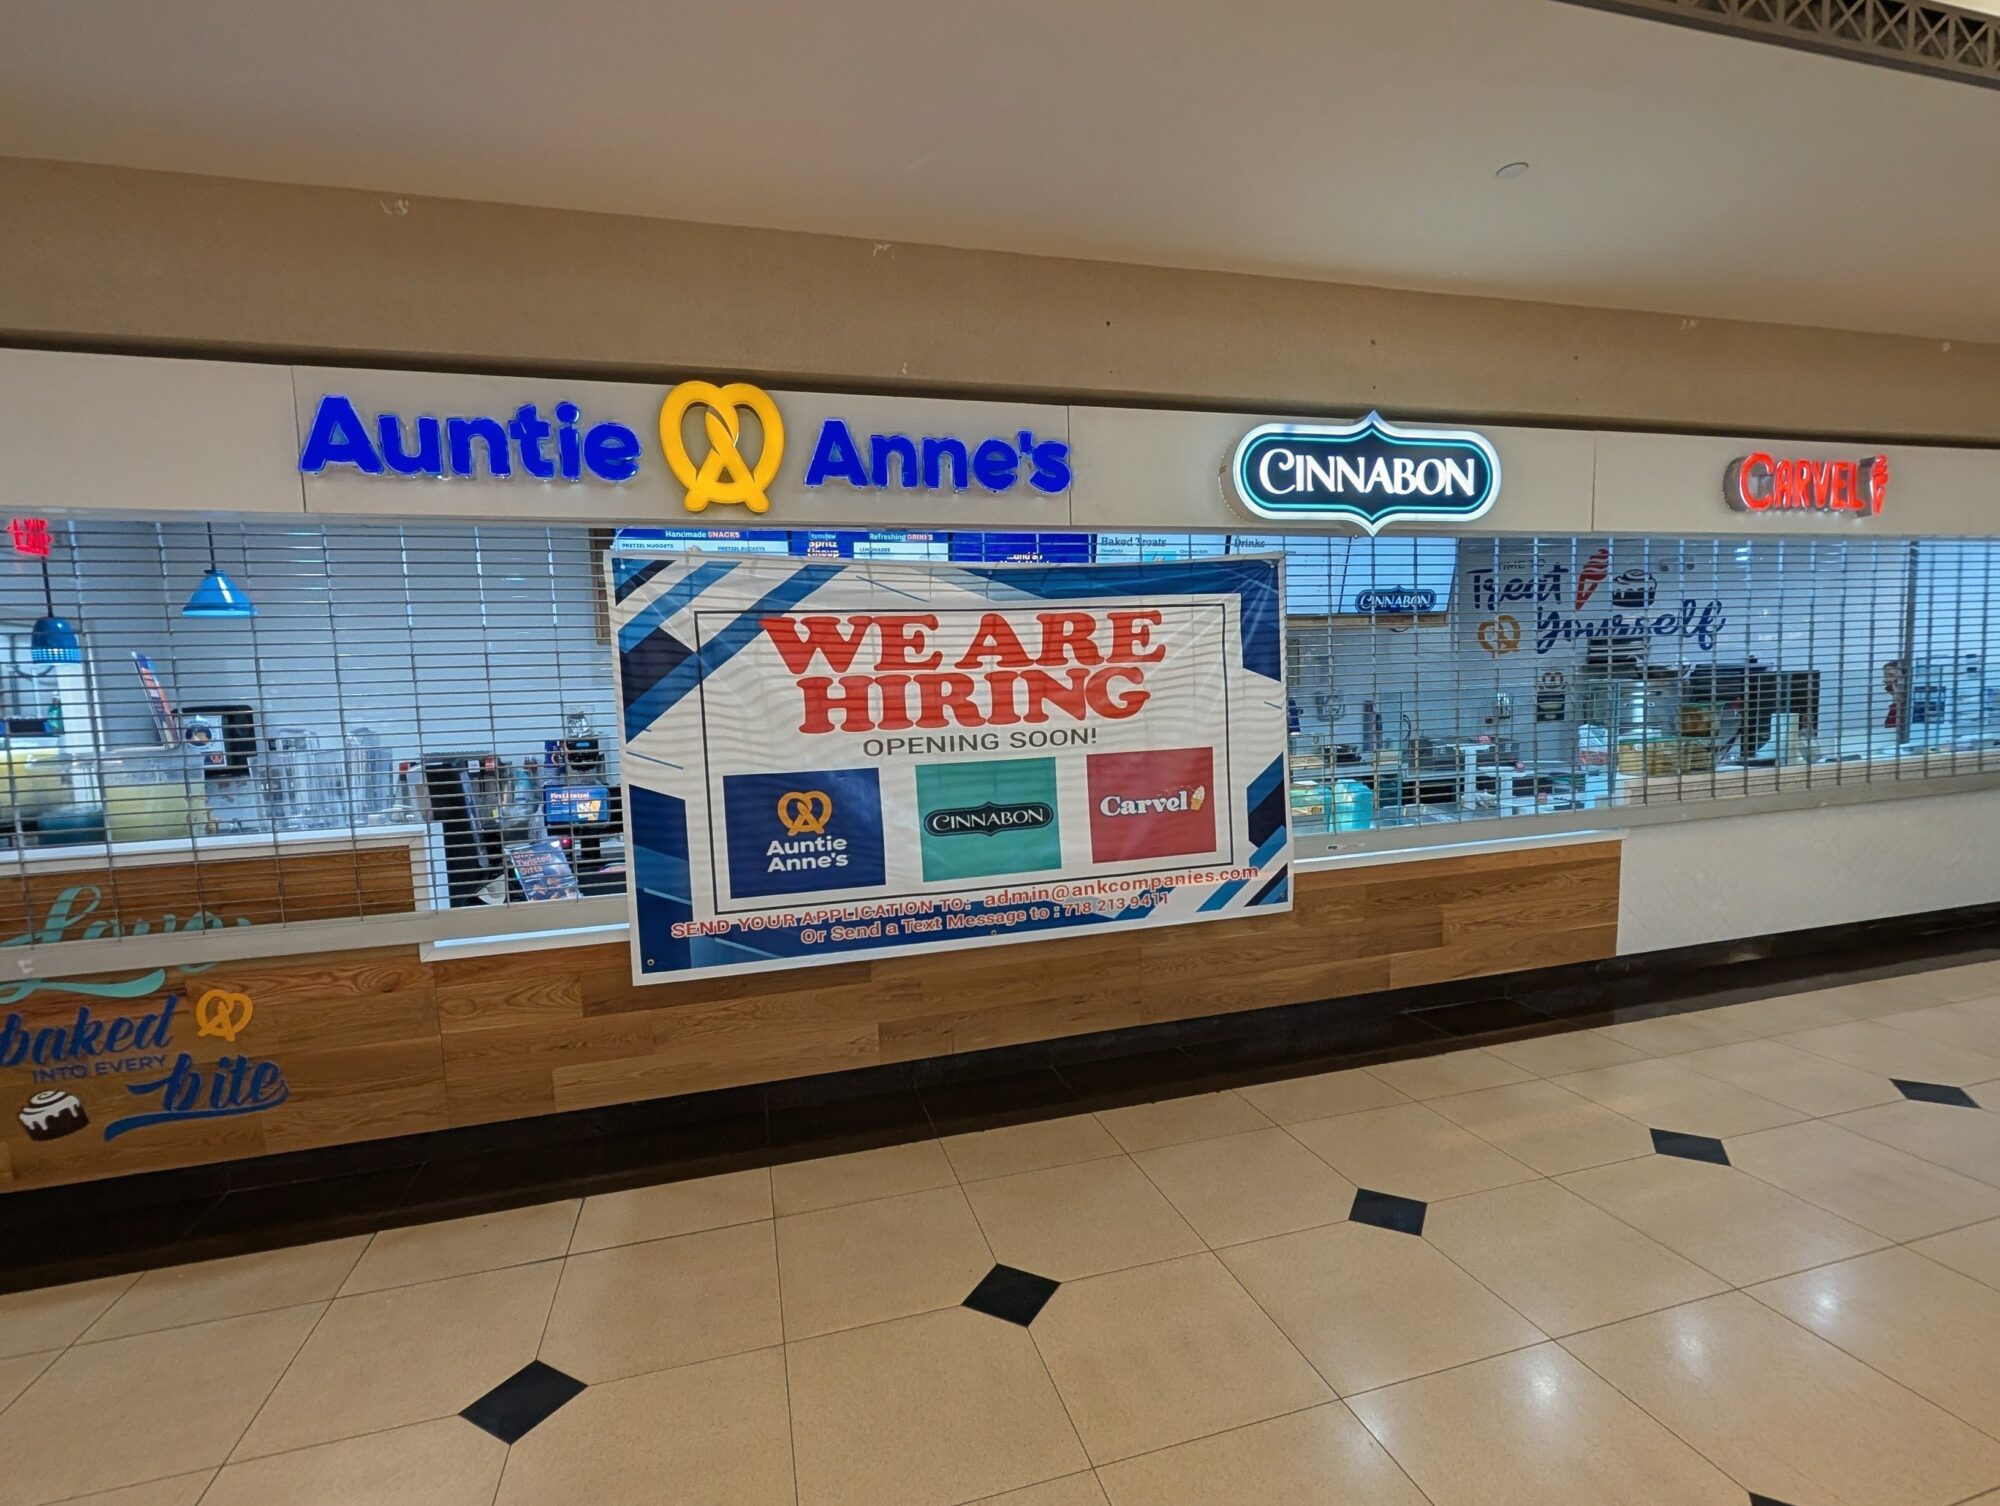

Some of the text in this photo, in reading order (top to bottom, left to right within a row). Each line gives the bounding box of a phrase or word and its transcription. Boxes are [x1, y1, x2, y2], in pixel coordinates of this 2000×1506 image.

[300, 394, 1071, 493] Auntie Anne's
[1259, 448, 1475, 496] CINNABON
[1740, 453, 1865, 511] CARVEL
[665, 530, 706, 538] Handmade
[869, 533, 906, 542] Refreshing
[1101, 536, 1166, 547] Baked Treats
[1234, 538, 1265, 549] Drinks
[758, 610, 1167, 674] WE ARE
[796, 666, 1151, 734] HIRING
[863, 727, 1098, 757] OPENING SOON!
[1099, 790, 1188, 817] Carvel
[932, 808, 1044, 831] CINNABON
[766, 835, 848, 856] Auntie
[767, 851, 849, 873] Anne's
[671, 866, 1259, 939] SEND YOUR APPLICATION TO: admin@ankcompanies.com
[800, 929, 826, 944] Or
[831, 923, 881, 941] Send
[886, 923, 898, 936] a
[900, 918, 942, 933] Text
[946, 911, 1026, 929] Message
[1030, 906, 1049, 920] to
[1063, 901, 1091, 916] 718
[1097, 897, 1126, 912] 213
[1130, 893, 1169, 909] 9411
[0, 993, 178, 1067] baked
[33, 1055, 166, 1083] INTO EVERY
[110, 1052, 290, 1128] bite
